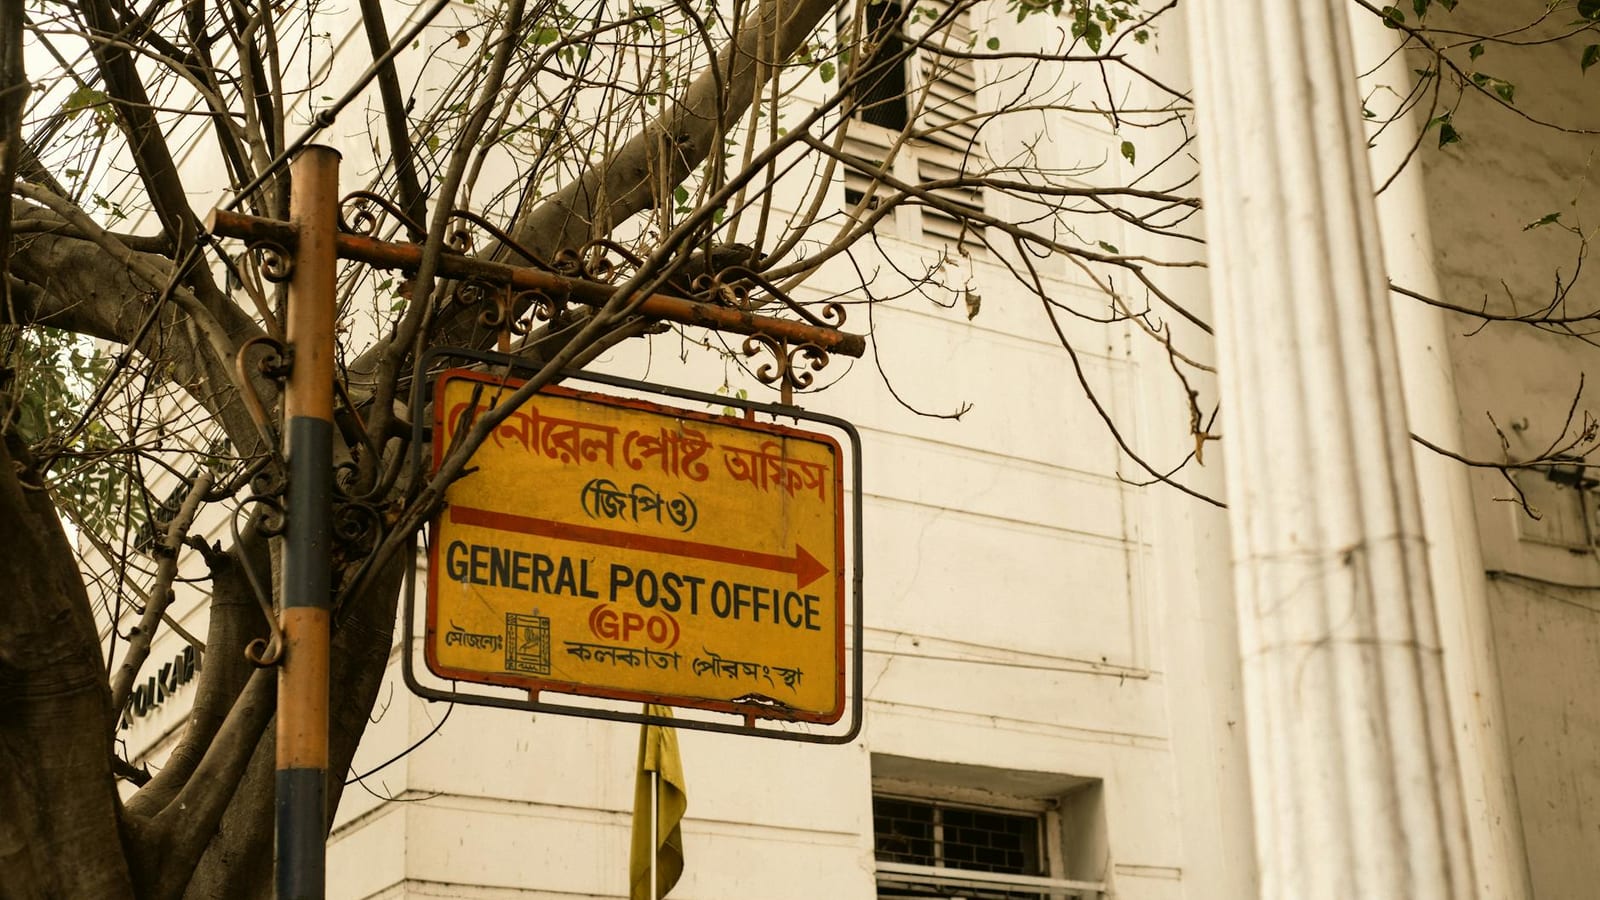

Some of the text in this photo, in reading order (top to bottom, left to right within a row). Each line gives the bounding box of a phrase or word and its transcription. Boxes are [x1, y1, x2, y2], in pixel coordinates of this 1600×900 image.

[719, 441, 829, 504] অফিস
[581, 478, 698, 533] (জিপিও)
[446, 540, 822, 631] GENERAL POST OFFICE
[588, 602, 681, 650] (GPO)
[563, 641, 683, 671] কলকাতা
[692, 645, 804, 694] পৌরসংস্থা
